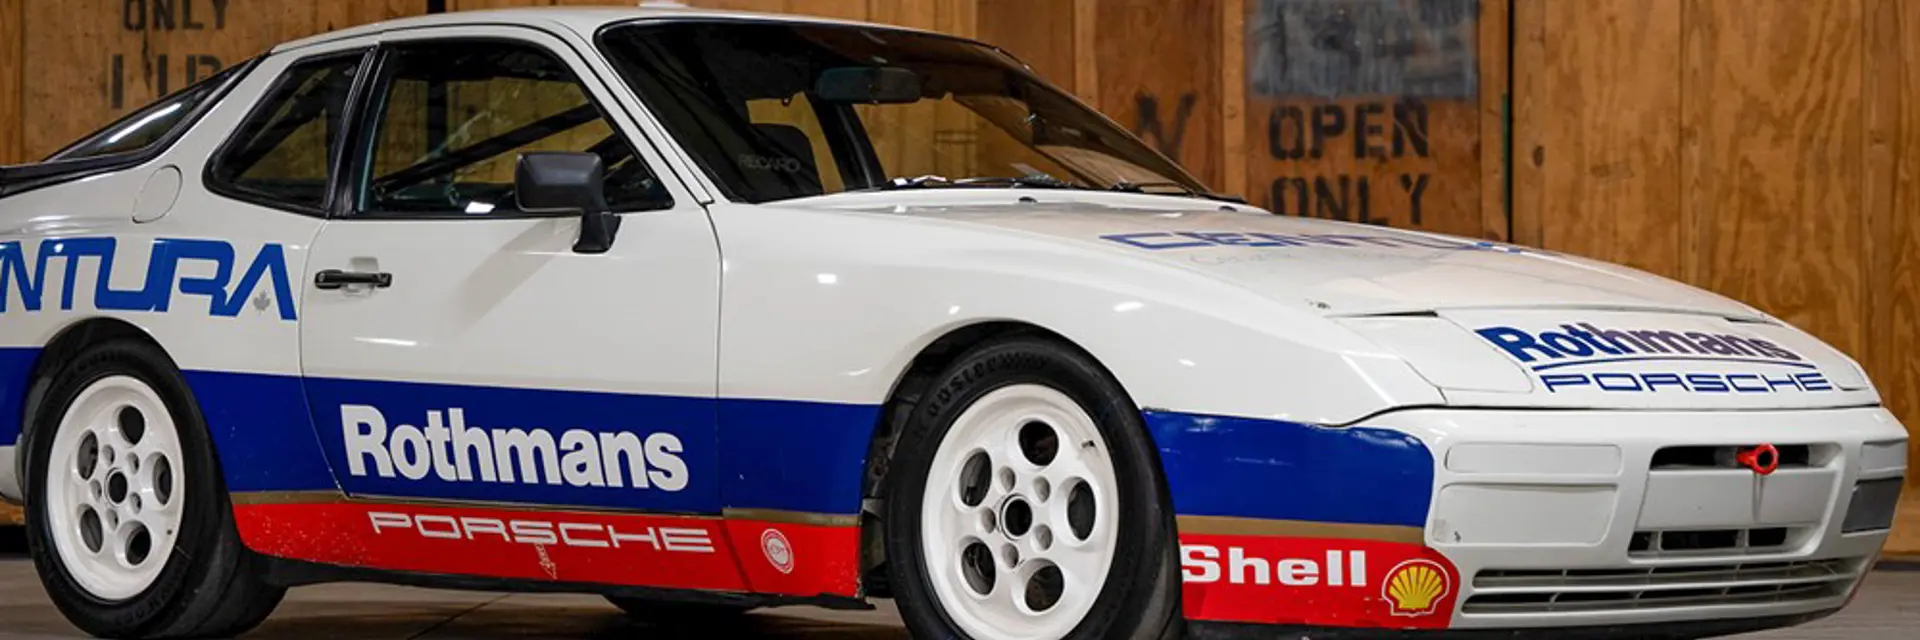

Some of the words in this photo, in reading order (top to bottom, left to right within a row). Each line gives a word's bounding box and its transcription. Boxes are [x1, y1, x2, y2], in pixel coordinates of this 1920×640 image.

[1269, 98, 1429, 160] OPEN
[1271, 173, 1430, 226] ONLY
[0, 236, 298, 321] NTURA
[1475, 323, 1802, 363] Rothmans
[1540, 372, 1833, 393] PORSCHE
[340, 403, 689, 492] Rothmans
[367, 511, 715, 553] PORSCHE
[1180, 544, 1367, 587] Shell
